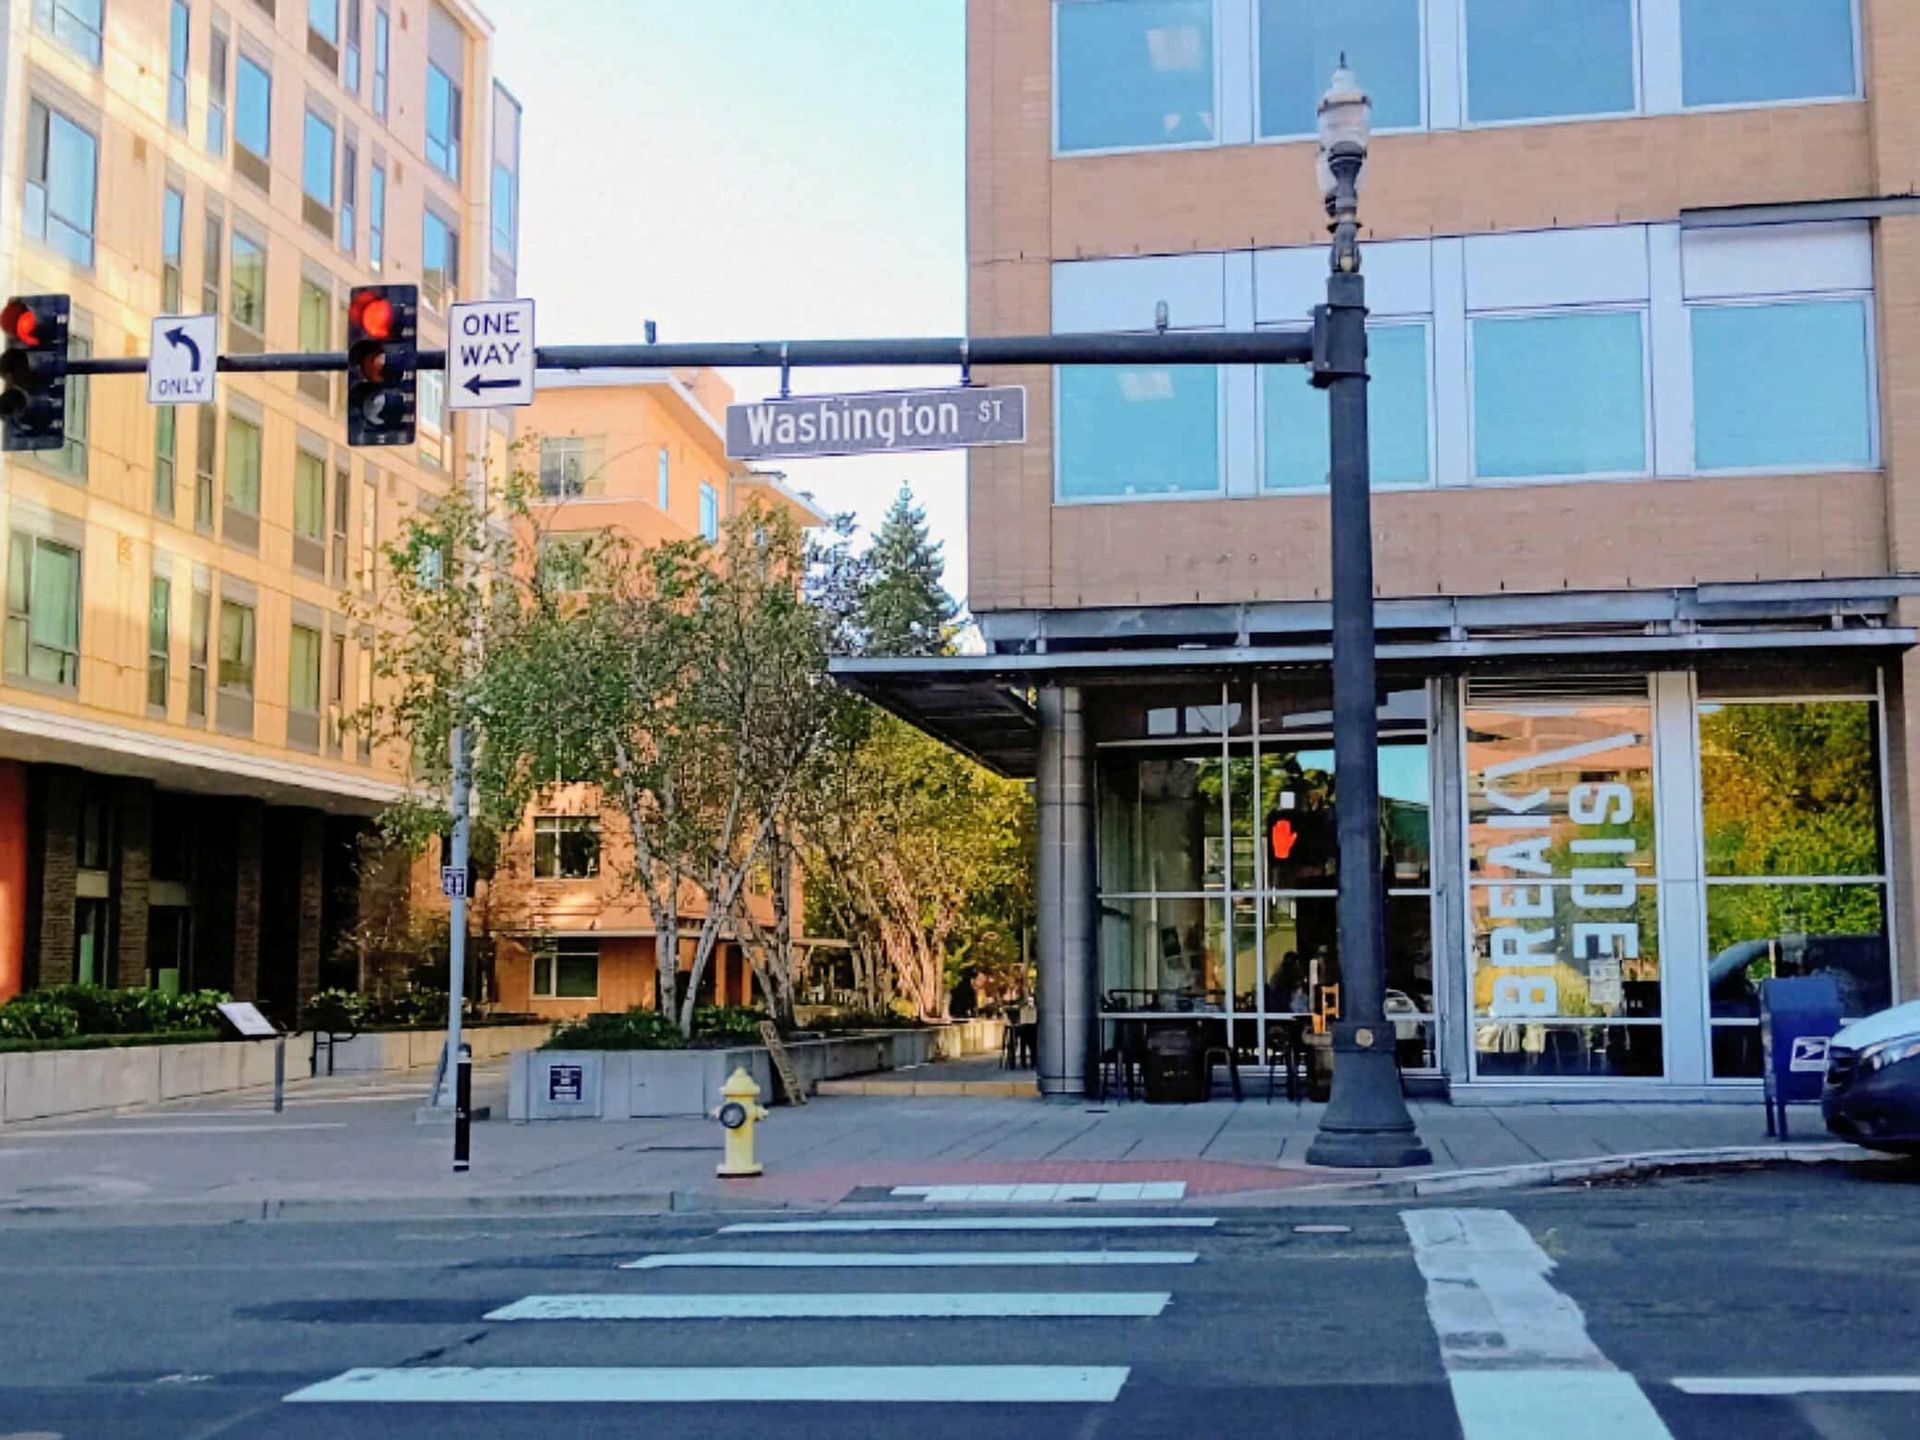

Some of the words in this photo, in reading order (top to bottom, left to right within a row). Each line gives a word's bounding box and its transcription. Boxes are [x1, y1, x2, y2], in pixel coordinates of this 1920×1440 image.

[463, 311, 519, 336] ONE
[461, 342, 520, 367] WAY
[158, 376, 205, 396] ONLY
[747, 399, 958, 446] Washington
[977, 400, 1004, 422] ST
[1570, 782, 1639, 959] SIDE
[1486, 786, 1559, 1017] BREAK
